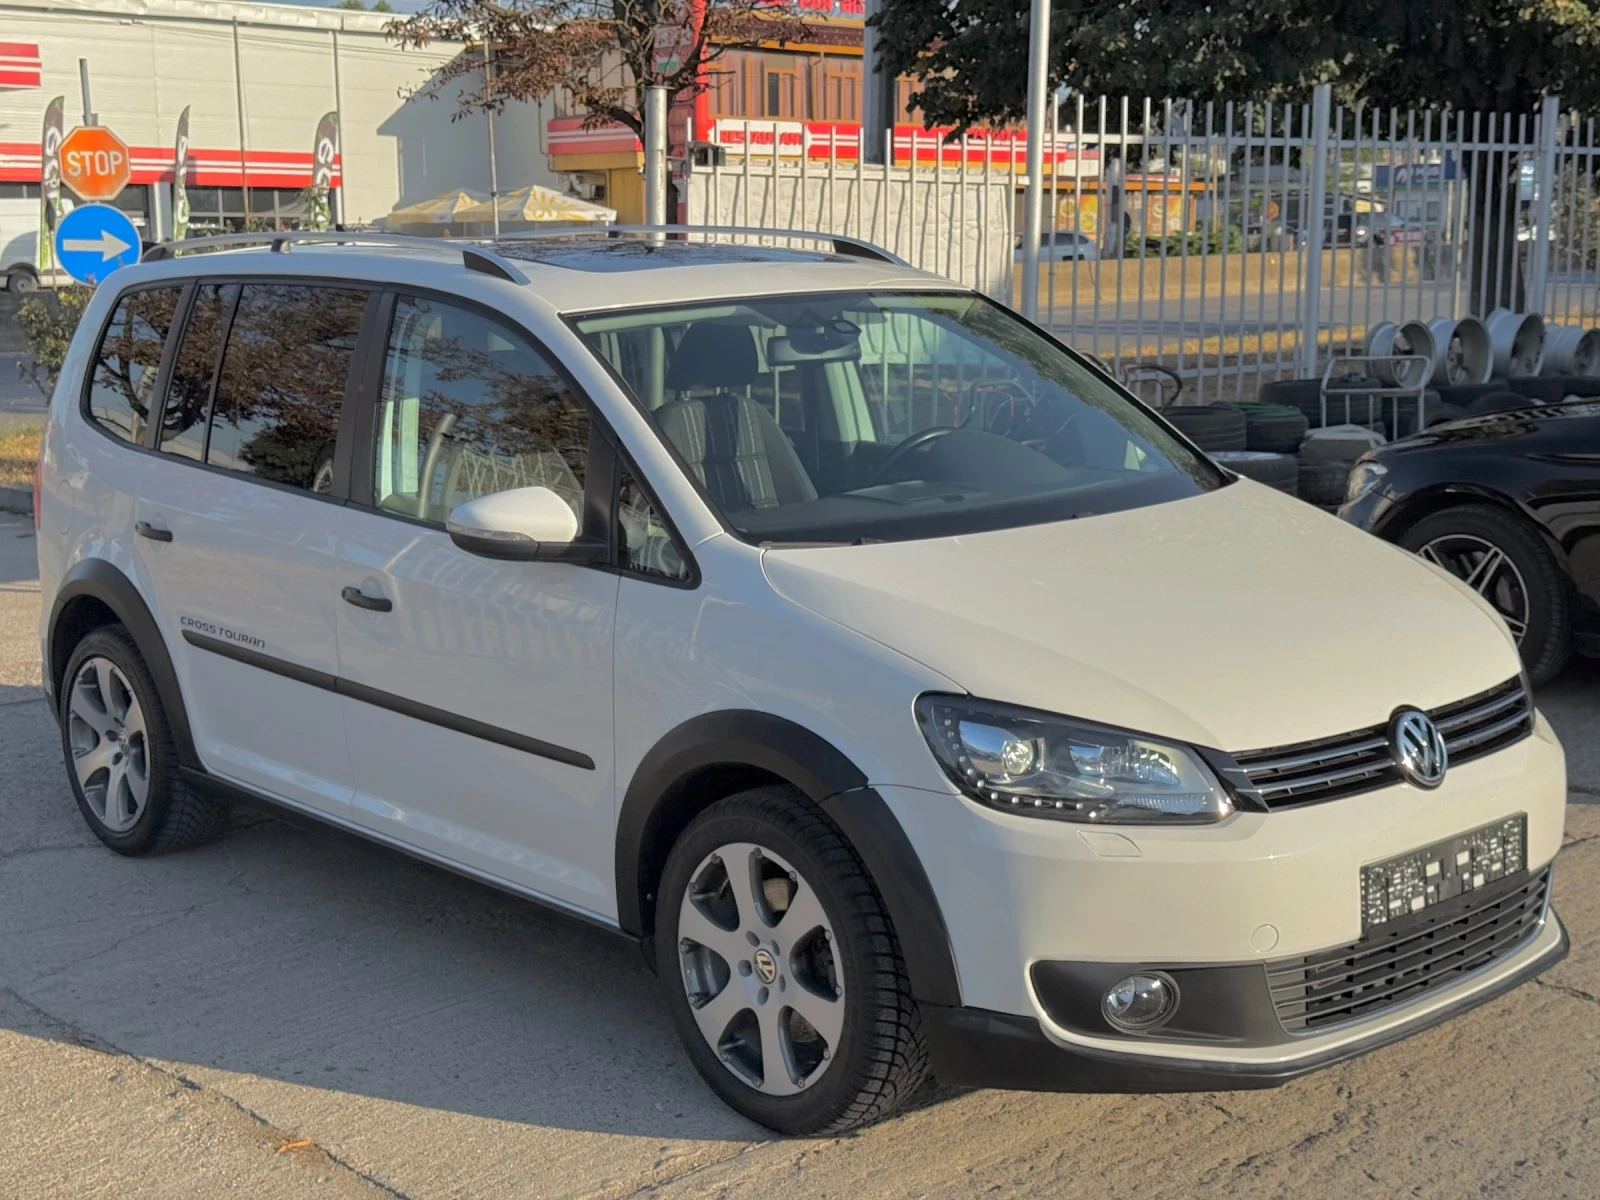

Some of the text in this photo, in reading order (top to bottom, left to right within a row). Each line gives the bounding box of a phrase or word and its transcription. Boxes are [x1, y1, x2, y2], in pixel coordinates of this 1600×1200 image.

[66, 151, 123, 177] STOP
[180, 616, 266, 649] CROSS TOURAN
